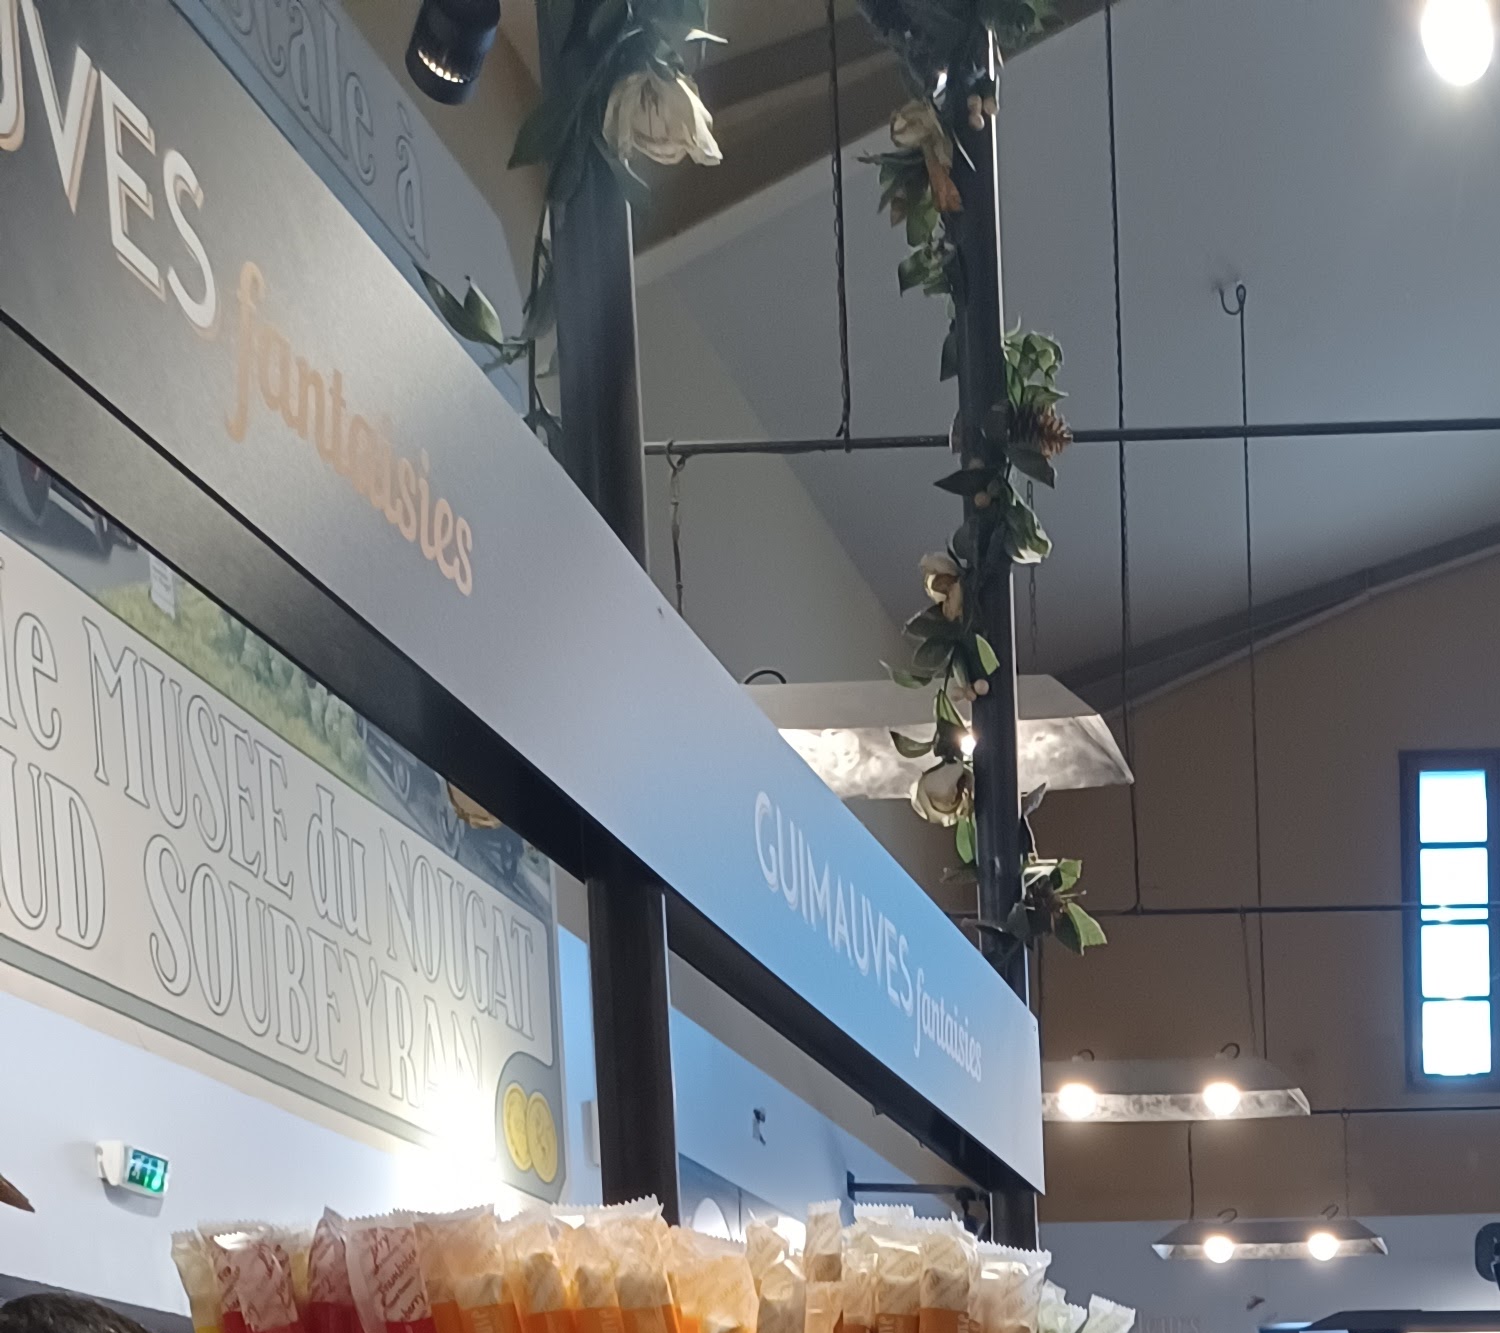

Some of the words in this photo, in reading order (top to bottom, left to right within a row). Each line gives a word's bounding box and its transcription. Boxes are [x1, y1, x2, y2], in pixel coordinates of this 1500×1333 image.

[225, 261, 475, 597] fantaisies
[81, 615, 294, 901] MUSEE
[307, 782, 373, 946] du
[379, 826, 536, 1043] NOUGAT
[143, 832, 484, 1109] SOUBEYRAN
[753, 790, 914, 1019] GUIMAUVES
[912, 966, 983, 1085] fantaisies
